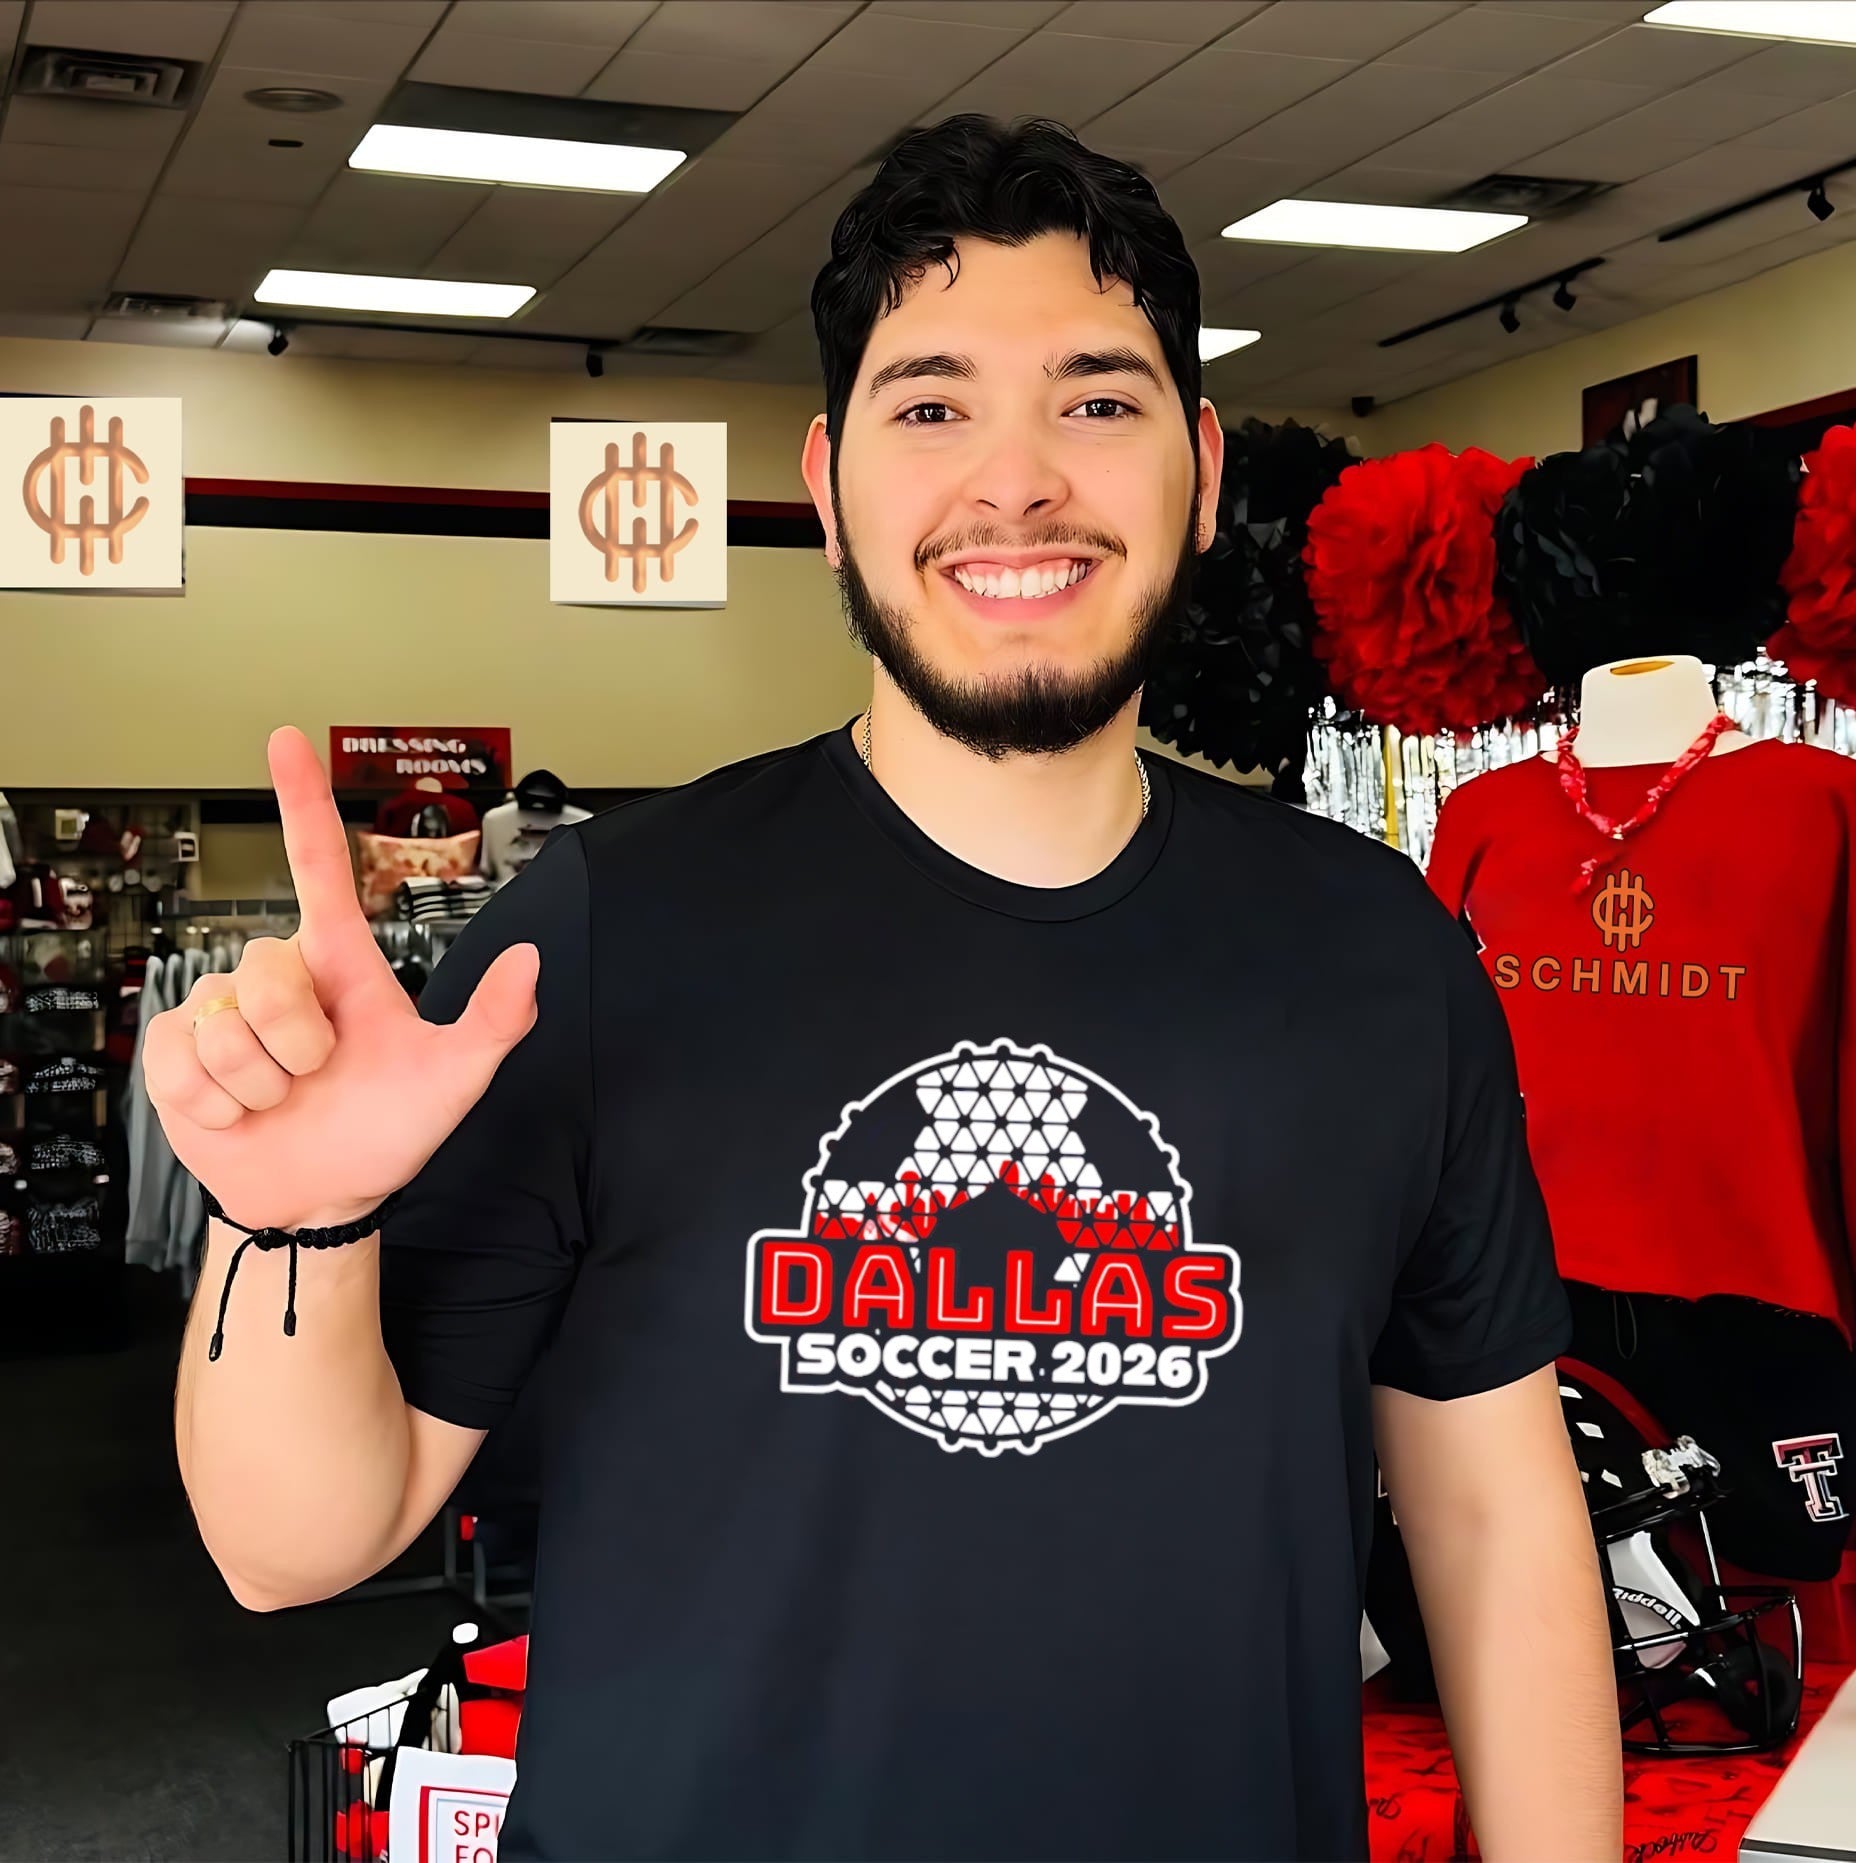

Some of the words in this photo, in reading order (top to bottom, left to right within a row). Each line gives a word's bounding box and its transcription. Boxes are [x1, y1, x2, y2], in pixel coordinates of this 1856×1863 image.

[1494, 954, 1746, 1000] SCHMIDT
[760, 1241, 1228, 1340] DALLAS
[796, 1332, 1037, 1383] SOCCER
[1051, 1340, 1194, 1389] 2026
